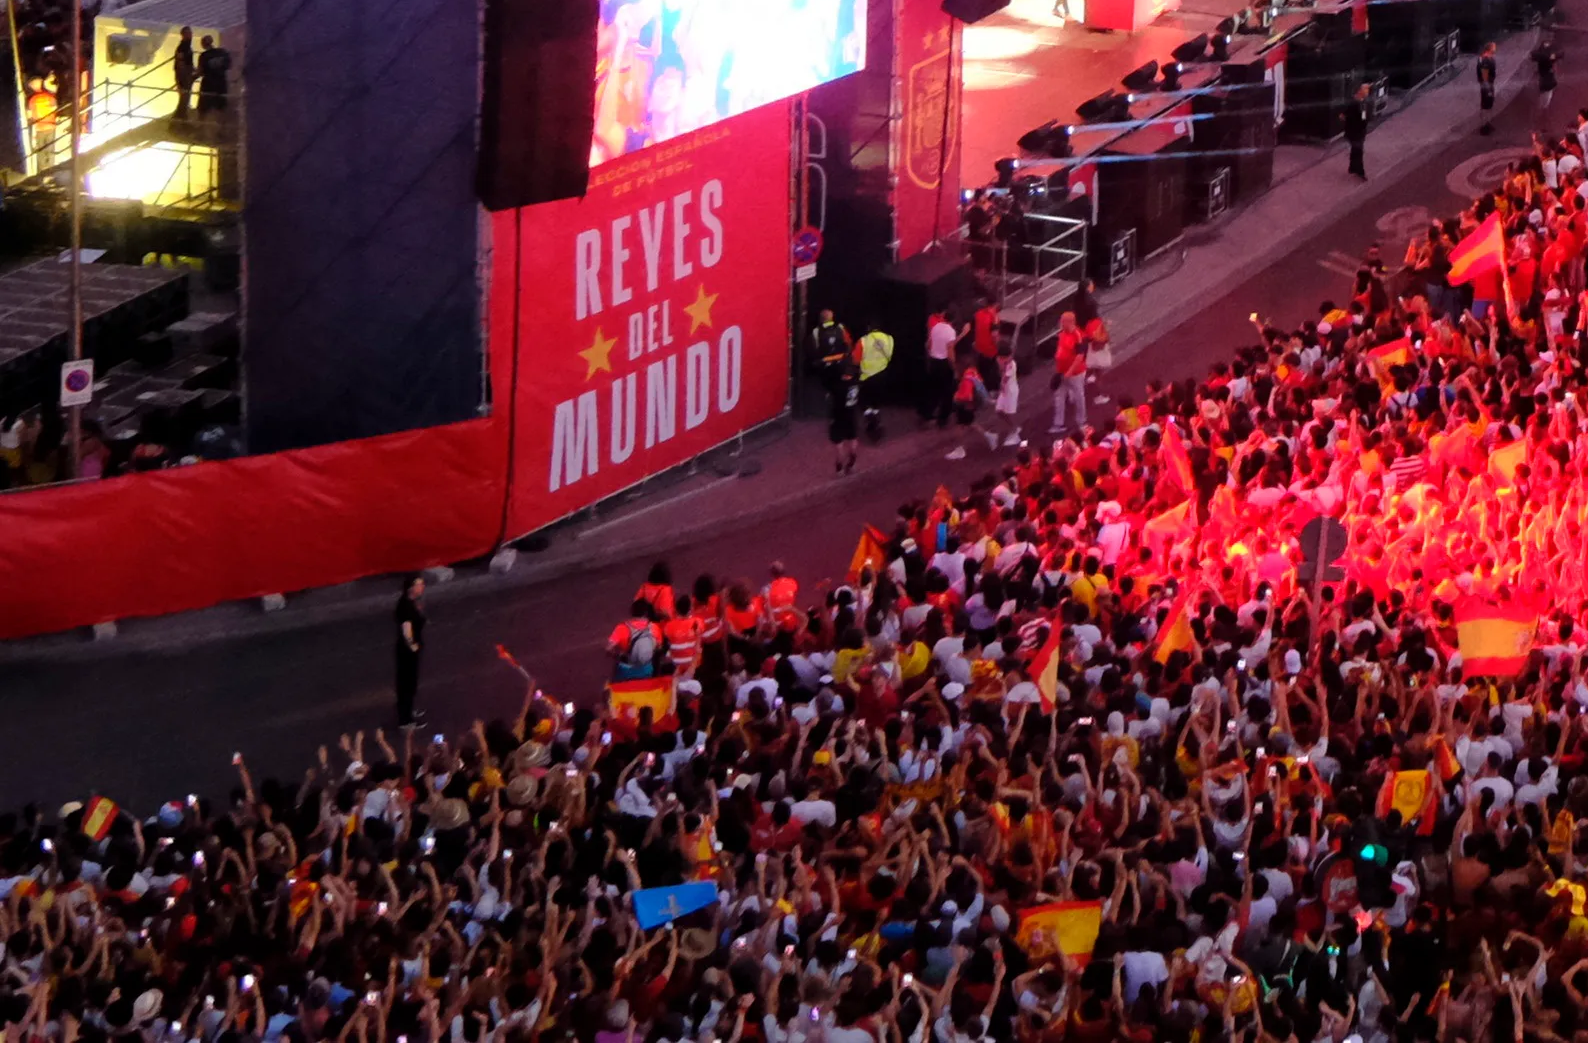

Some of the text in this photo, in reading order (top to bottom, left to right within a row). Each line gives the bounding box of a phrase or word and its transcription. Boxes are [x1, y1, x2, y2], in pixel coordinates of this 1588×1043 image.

[574, 178, 724, 322] REYES
[628, 299, 674, 361] DEL
[549, 324, 743, 494] MUNDO
